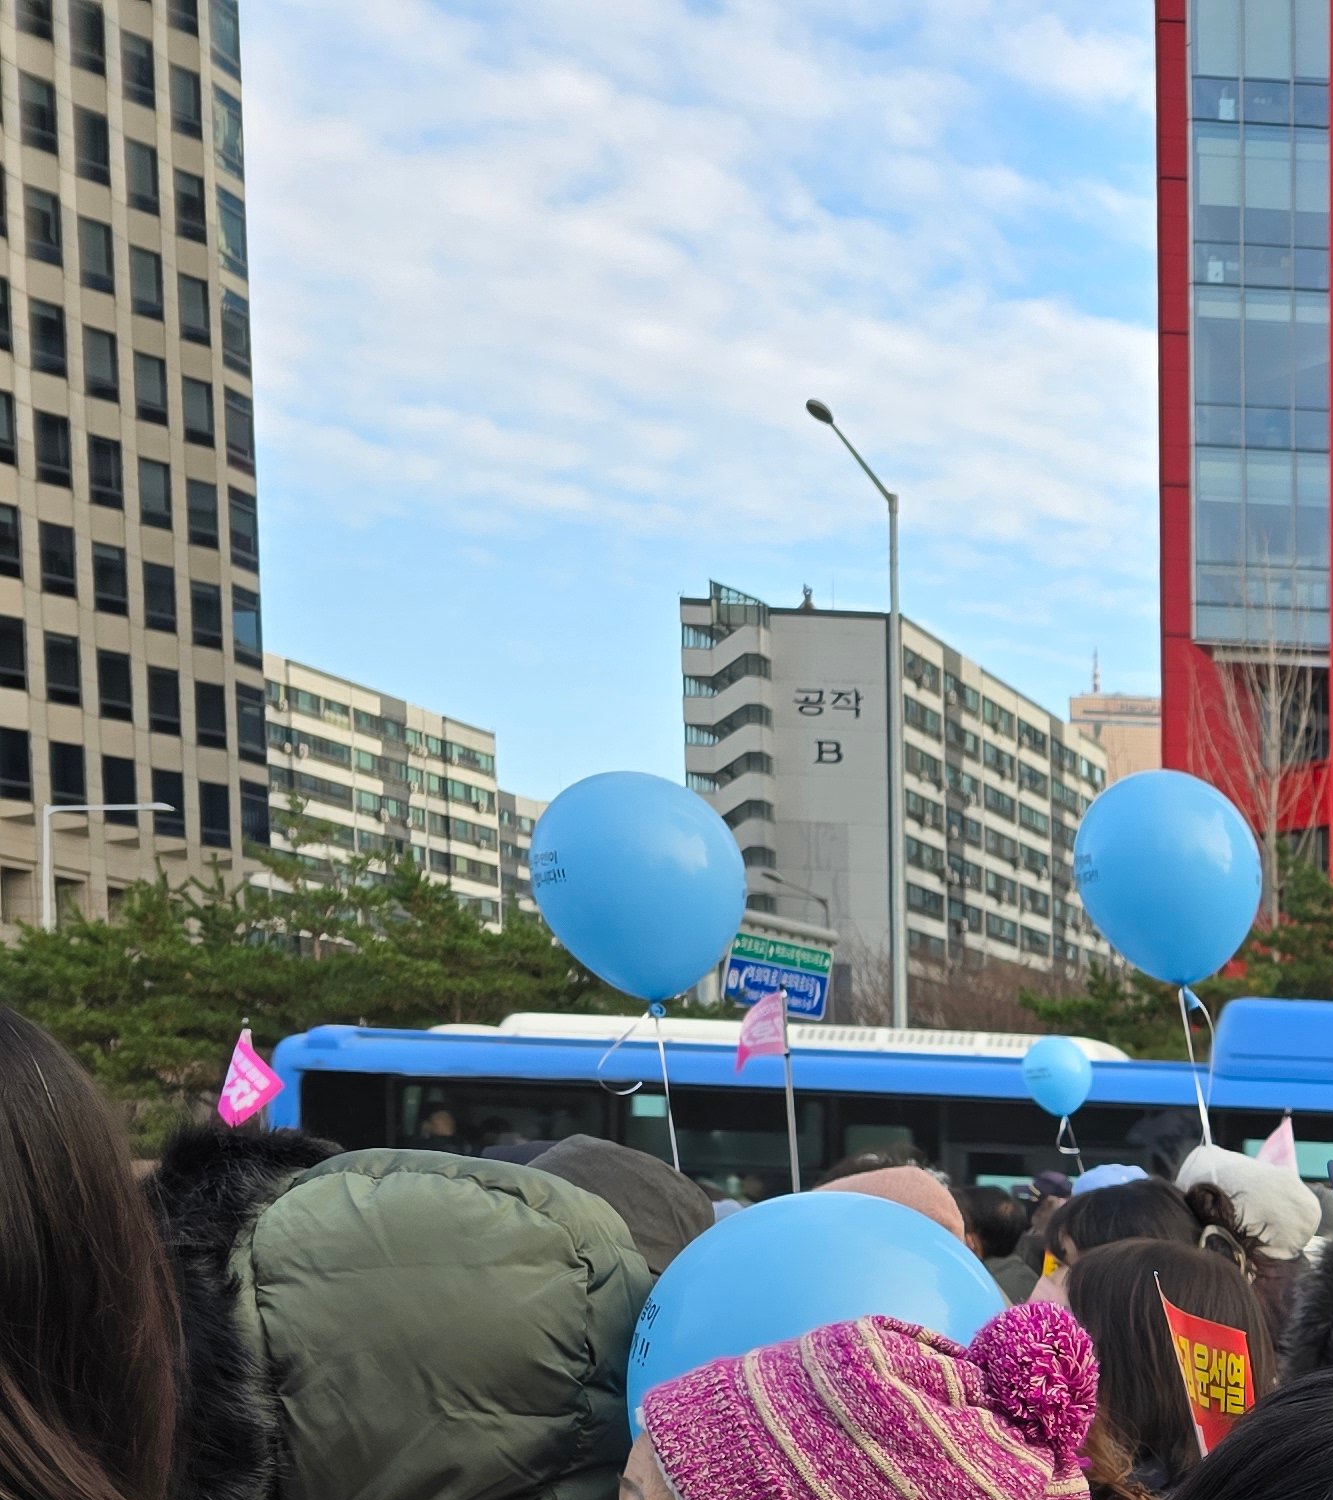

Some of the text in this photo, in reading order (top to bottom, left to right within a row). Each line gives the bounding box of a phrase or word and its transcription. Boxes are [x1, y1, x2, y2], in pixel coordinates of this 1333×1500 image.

[793, 686, 864, 719] 공작
[814, 739, 843, 764] B
[1193, 1342, 1245, 1415] 윤석열
